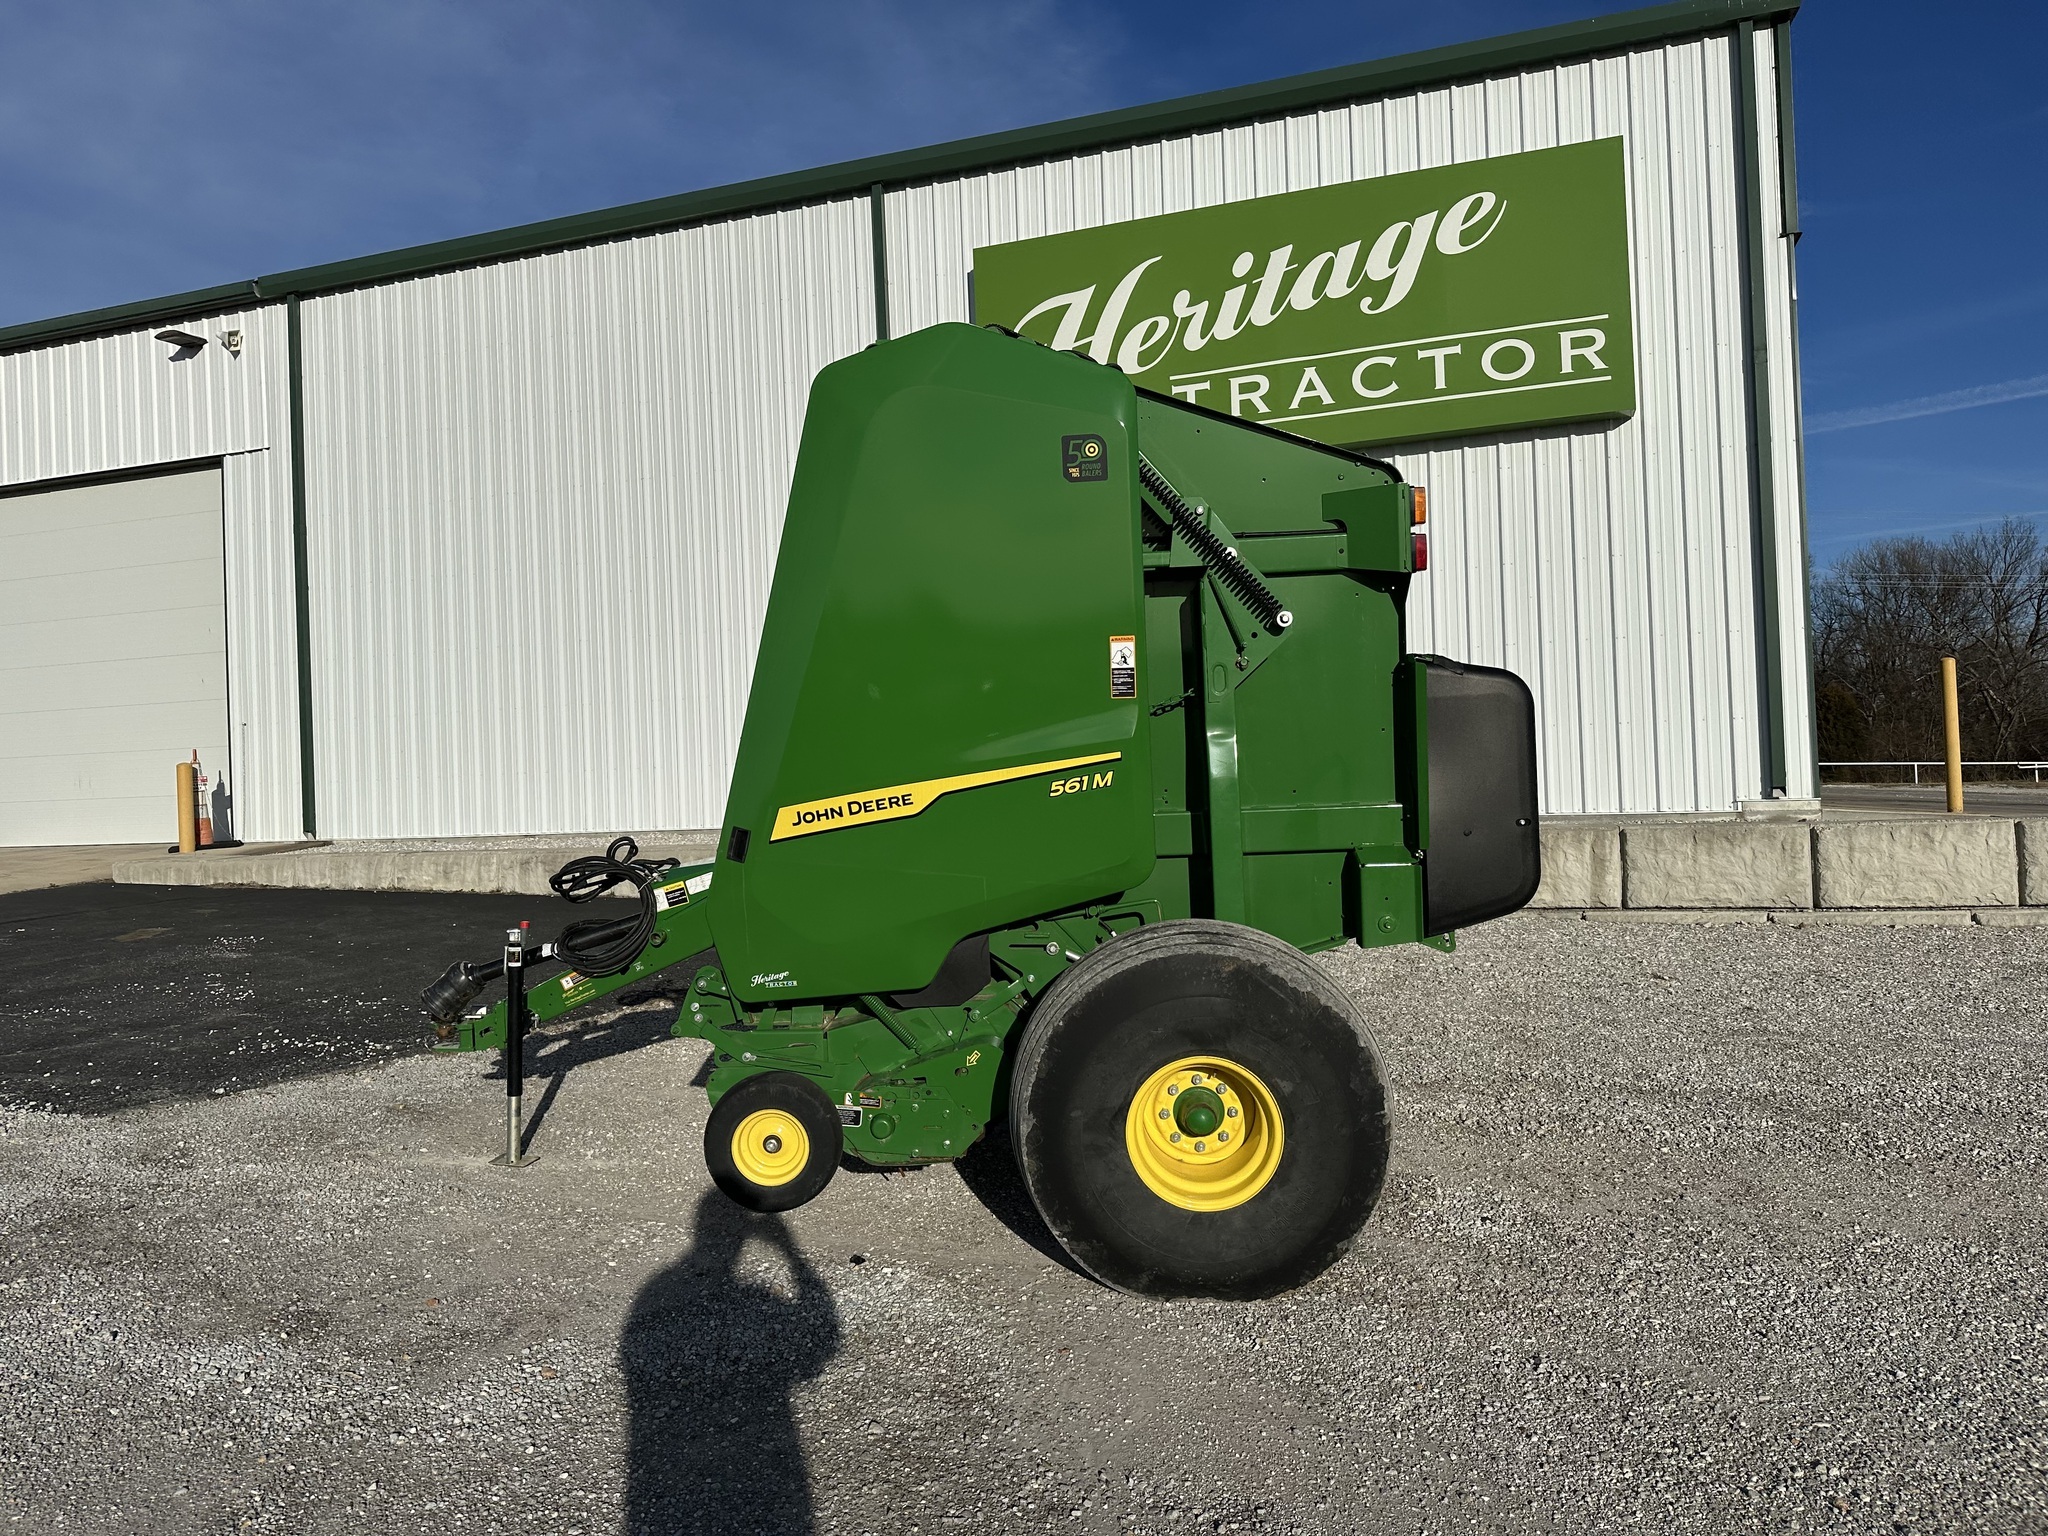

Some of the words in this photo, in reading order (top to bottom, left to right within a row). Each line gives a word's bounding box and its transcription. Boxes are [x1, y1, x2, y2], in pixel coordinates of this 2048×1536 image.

[1014, 187, 1508, 375] Heritage
[1171, 327, 1609, 418] TRACTOR
[792, 806, 844, 827] JOHN
[847, 793, 914, 816] DEERE
[750, 970, 790, 988] Heritage
[764, 980, 798, 989] TRACTOR
